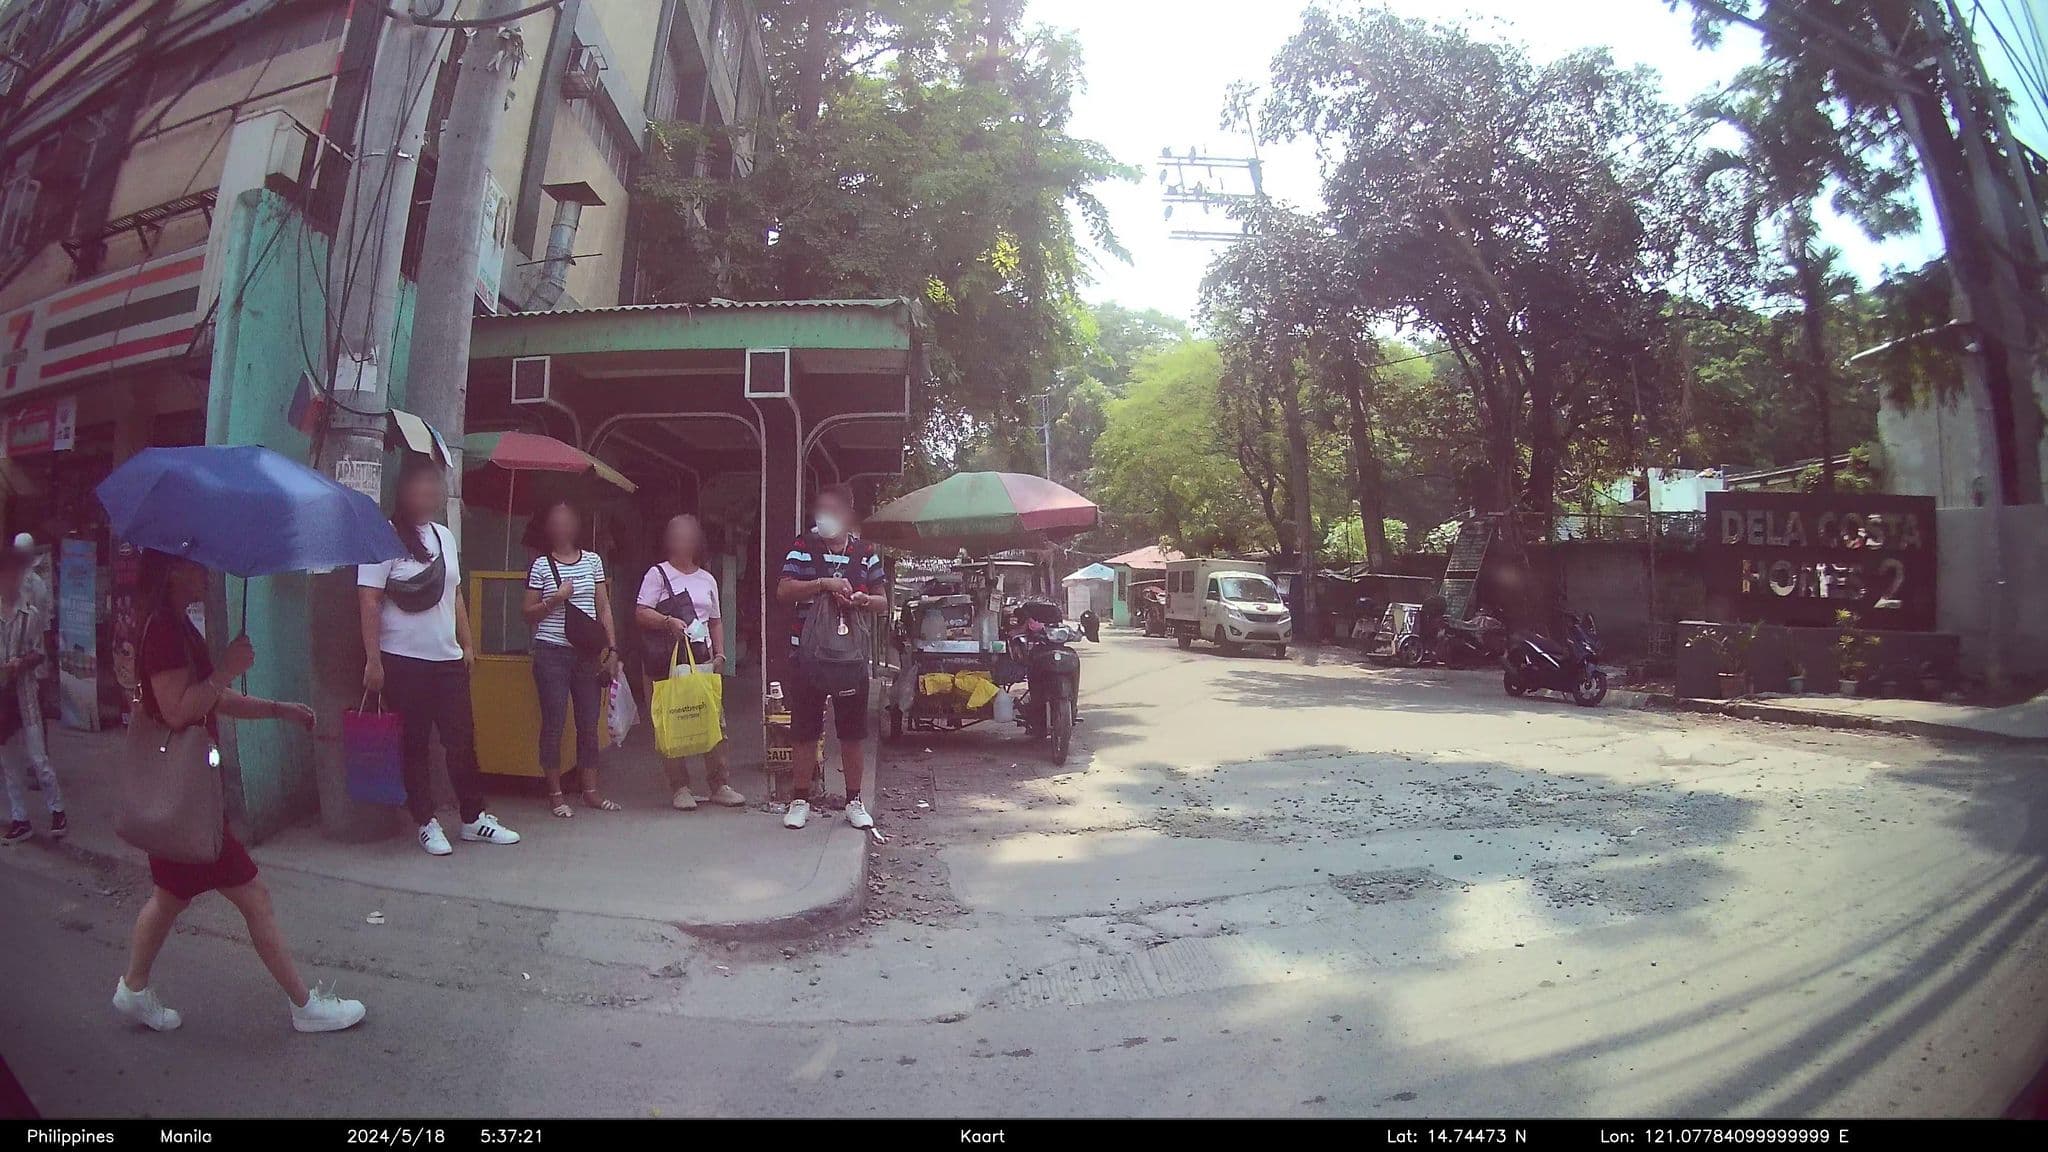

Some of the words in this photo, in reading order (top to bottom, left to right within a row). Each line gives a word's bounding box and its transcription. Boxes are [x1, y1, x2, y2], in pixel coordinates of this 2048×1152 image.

[1721, 509, 1808, 547] DELA
[1819, 511, 1923, 551] COSTA
[1874, 558, 1906, 608] 2
